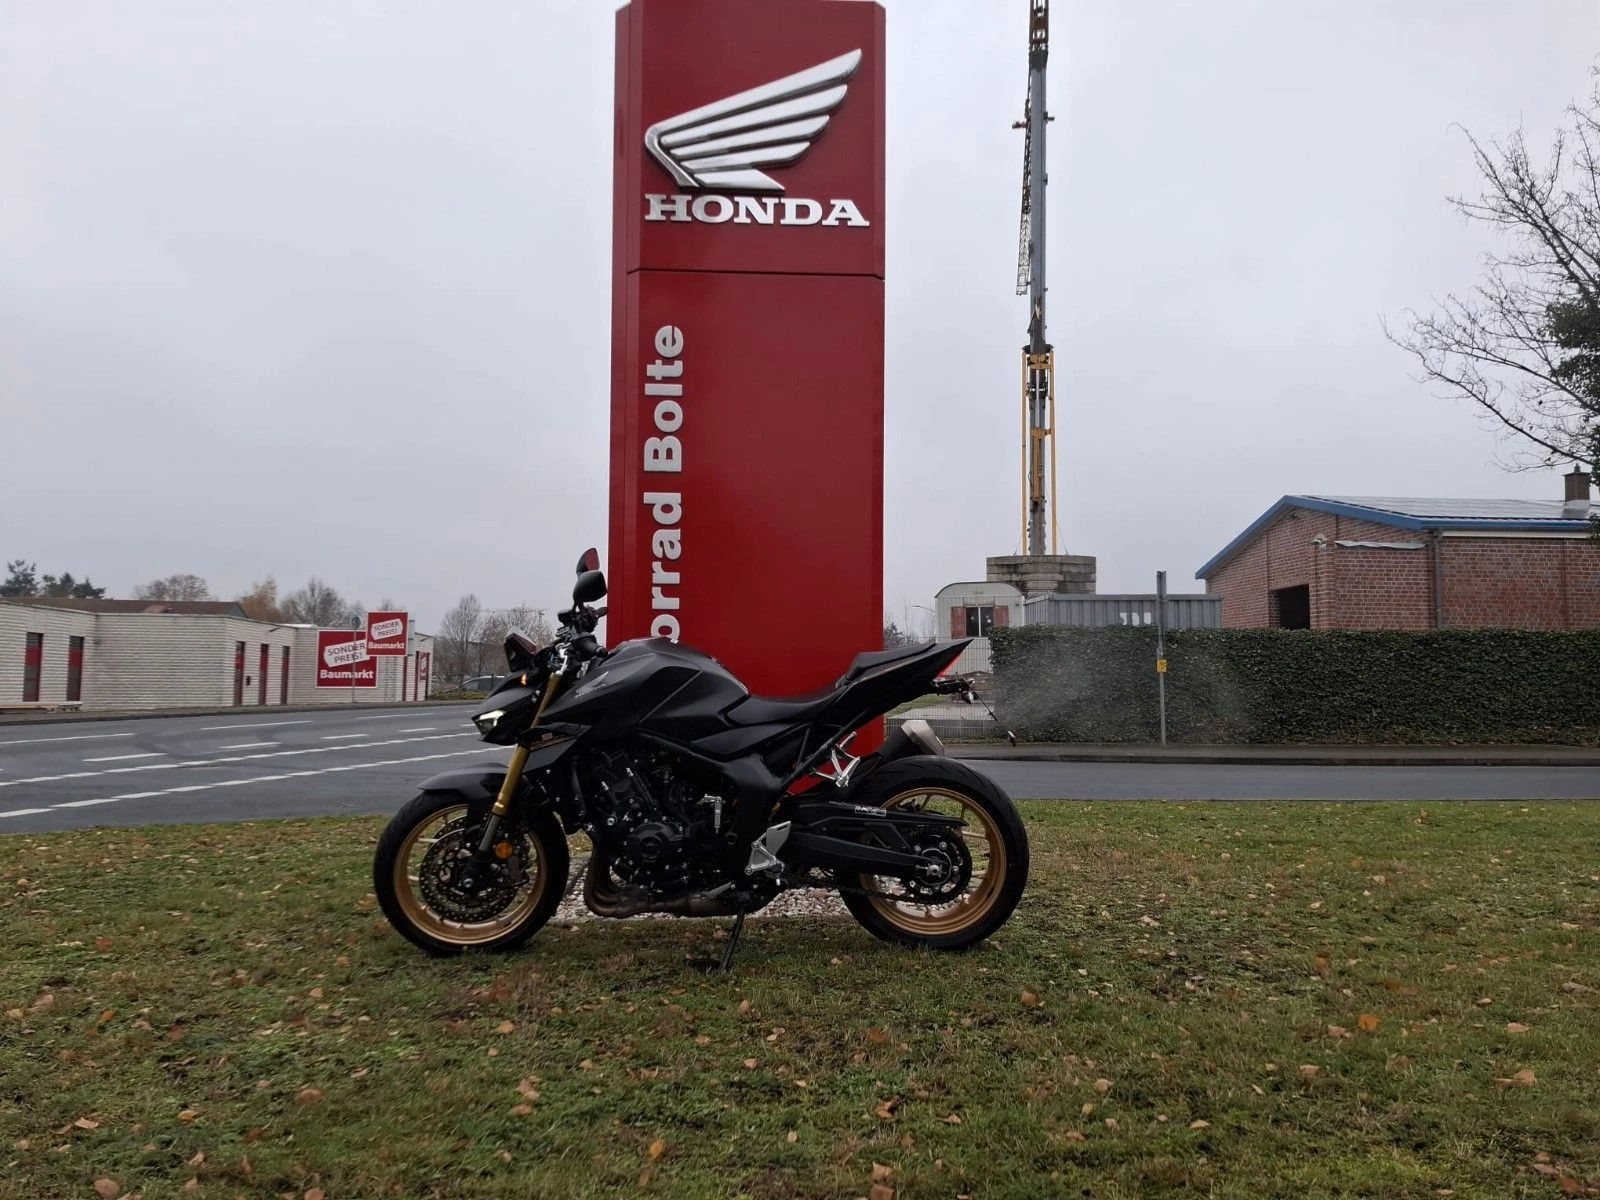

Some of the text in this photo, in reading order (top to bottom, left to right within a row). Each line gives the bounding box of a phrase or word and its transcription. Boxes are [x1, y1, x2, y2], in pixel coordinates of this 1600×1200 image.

[645, 194, 870, 226] HONDA
[643, 325, 684, 642] orrad Bolte
[373, 621, 400, 631] SONDER
[327, 642, 366, 656] SONDER
[368, 641, 404, 649] Baumarkt
[320, 669, 374, 679] Baumarkt
